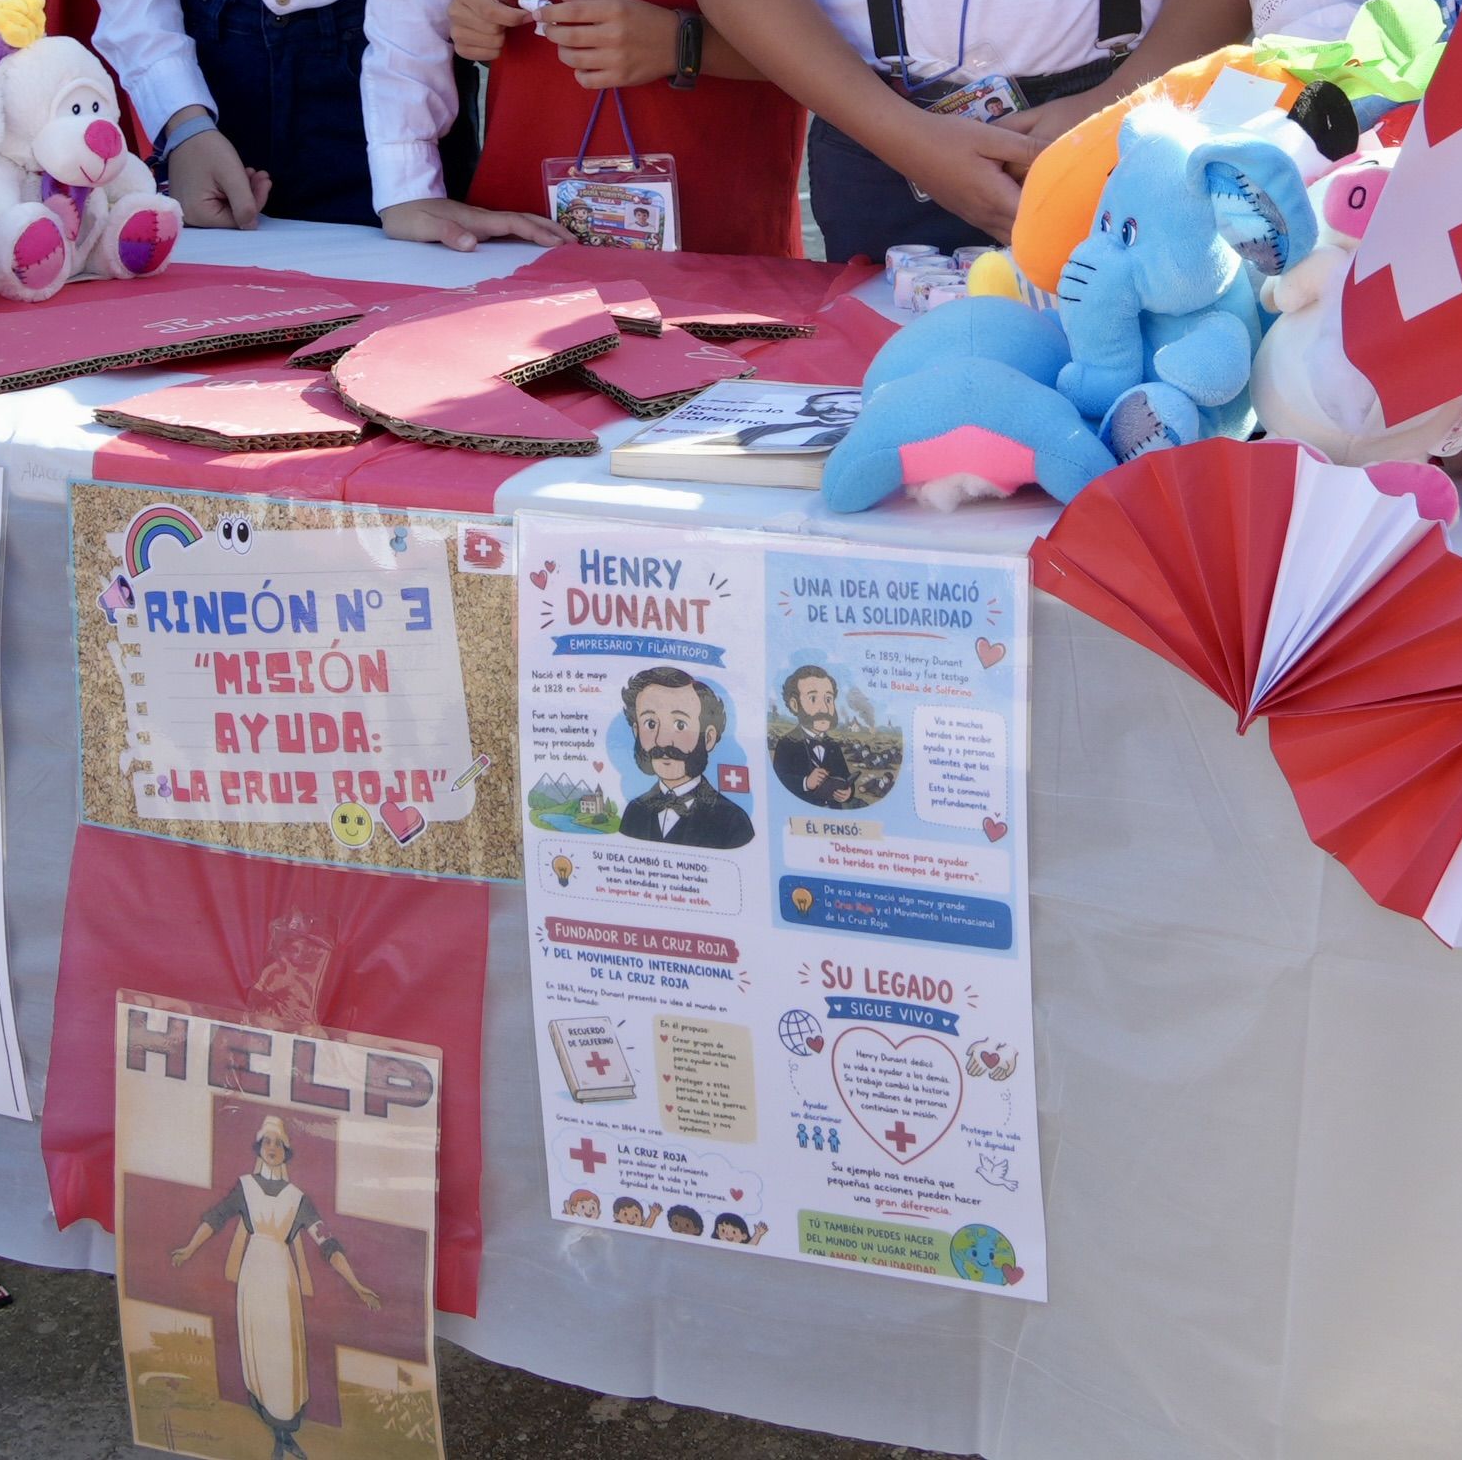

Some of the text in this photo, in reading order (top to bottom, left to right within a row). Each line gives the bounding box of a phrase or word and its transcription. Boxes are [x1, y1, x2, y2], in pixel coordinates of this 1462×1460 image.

[671, 415, 767, 425] Solferino
[686, 405, 784, 414] Recuerdo
[580, 548, 682, 590] HENRY
[144, 579, 318, 636] RINCÓN
[399, 587, 432, 632] 3
[793, 577, 979, 603] UNA IDEA QUE NACIÓ
[567, 588, 711, 634] DUNANT
[808, 605, 973, 628] DE LA SOLIDARIDAD
[214, 711, 383, 754] AYUDA:
[170, 768, 210, 803] LA
[220, 771, 318, 804] CRUZ
[555, 922, 728, 958] FUNDADOR DE LA CRUZ ROJA
[542, 946, 733, 981] Y DEL MOVIMIENTO INTERNACIONAL
[591, 968, 689, 990] DE LA CRUZ ROJA
[820, 959, 953, 1004] SU LEGADO
[850, 1002, 934, 1026] SIGUE VIVO
[125, 1008, 435, 1118] HELP
